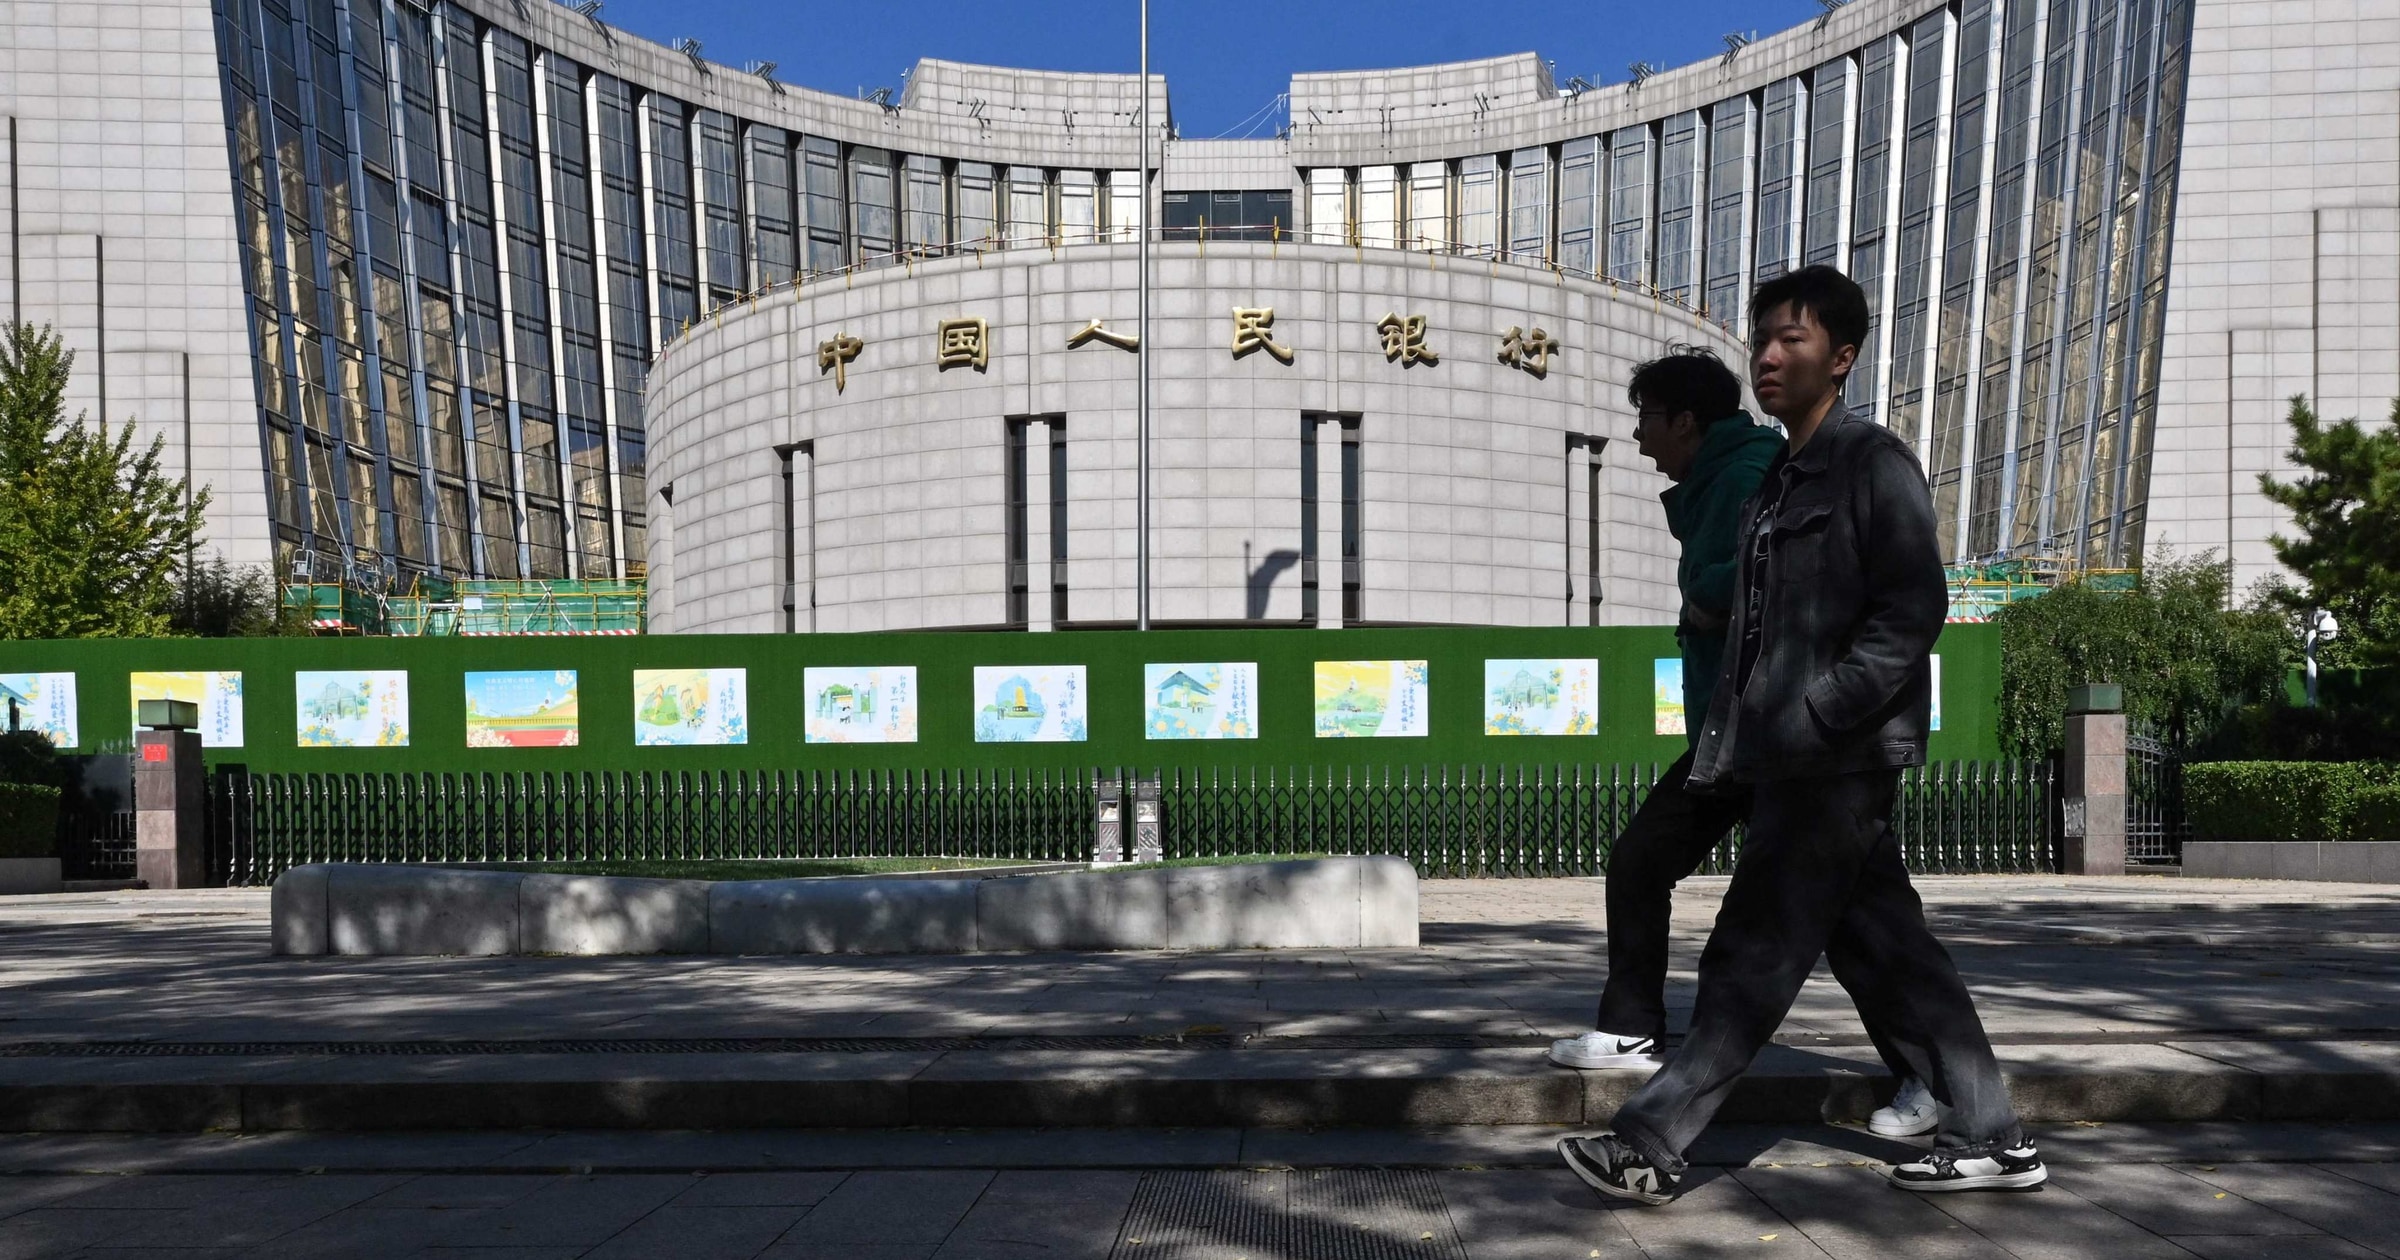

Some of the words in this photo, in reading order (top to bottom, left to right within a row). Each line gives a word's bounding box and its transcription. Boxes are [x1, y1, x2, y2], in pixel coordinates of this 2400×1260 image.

[818, 306, 1559, 393] 中国人民银行
